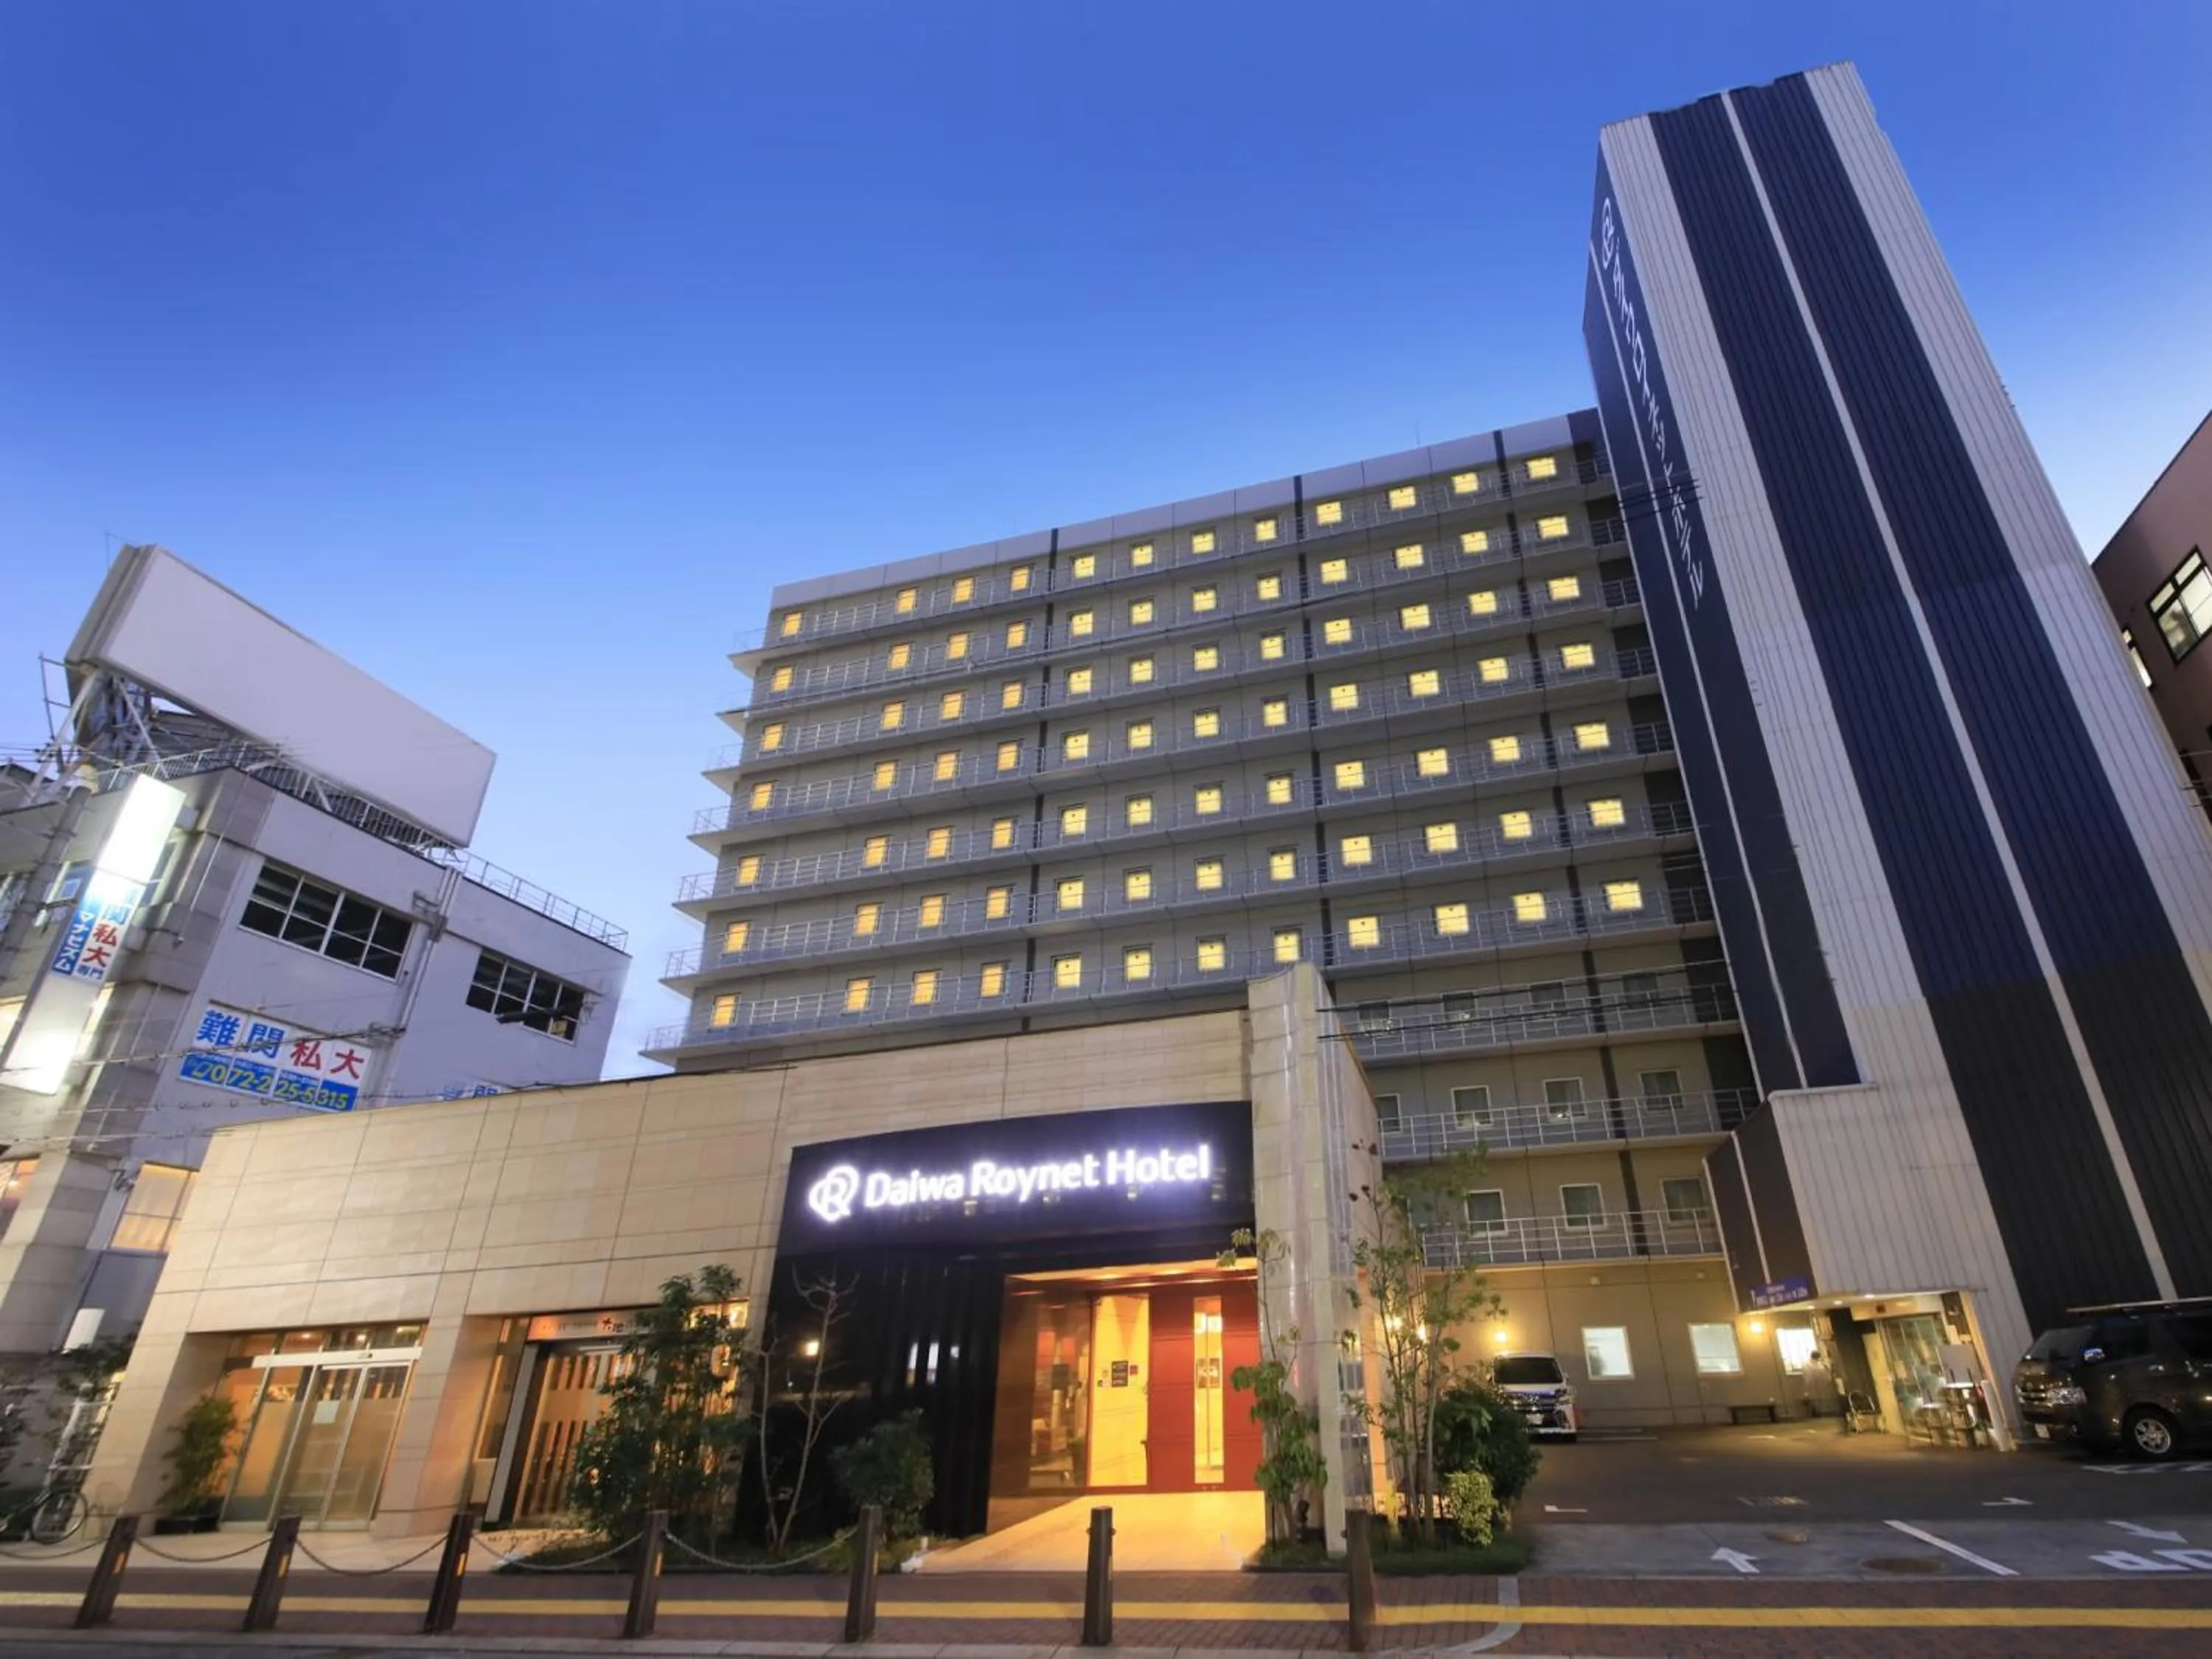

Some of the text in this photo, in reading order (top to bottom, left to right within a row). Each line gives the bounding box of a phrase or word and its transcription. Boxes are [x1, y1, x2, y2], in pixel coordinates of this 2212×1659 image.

[195, 1009, 365, 1080] 難関私大
[863, 1169, 965, 1208] Daiwa
[970, 1154, 1101, 1203] Roynet
[1106, 1144, 1210, 1186] Hotel
